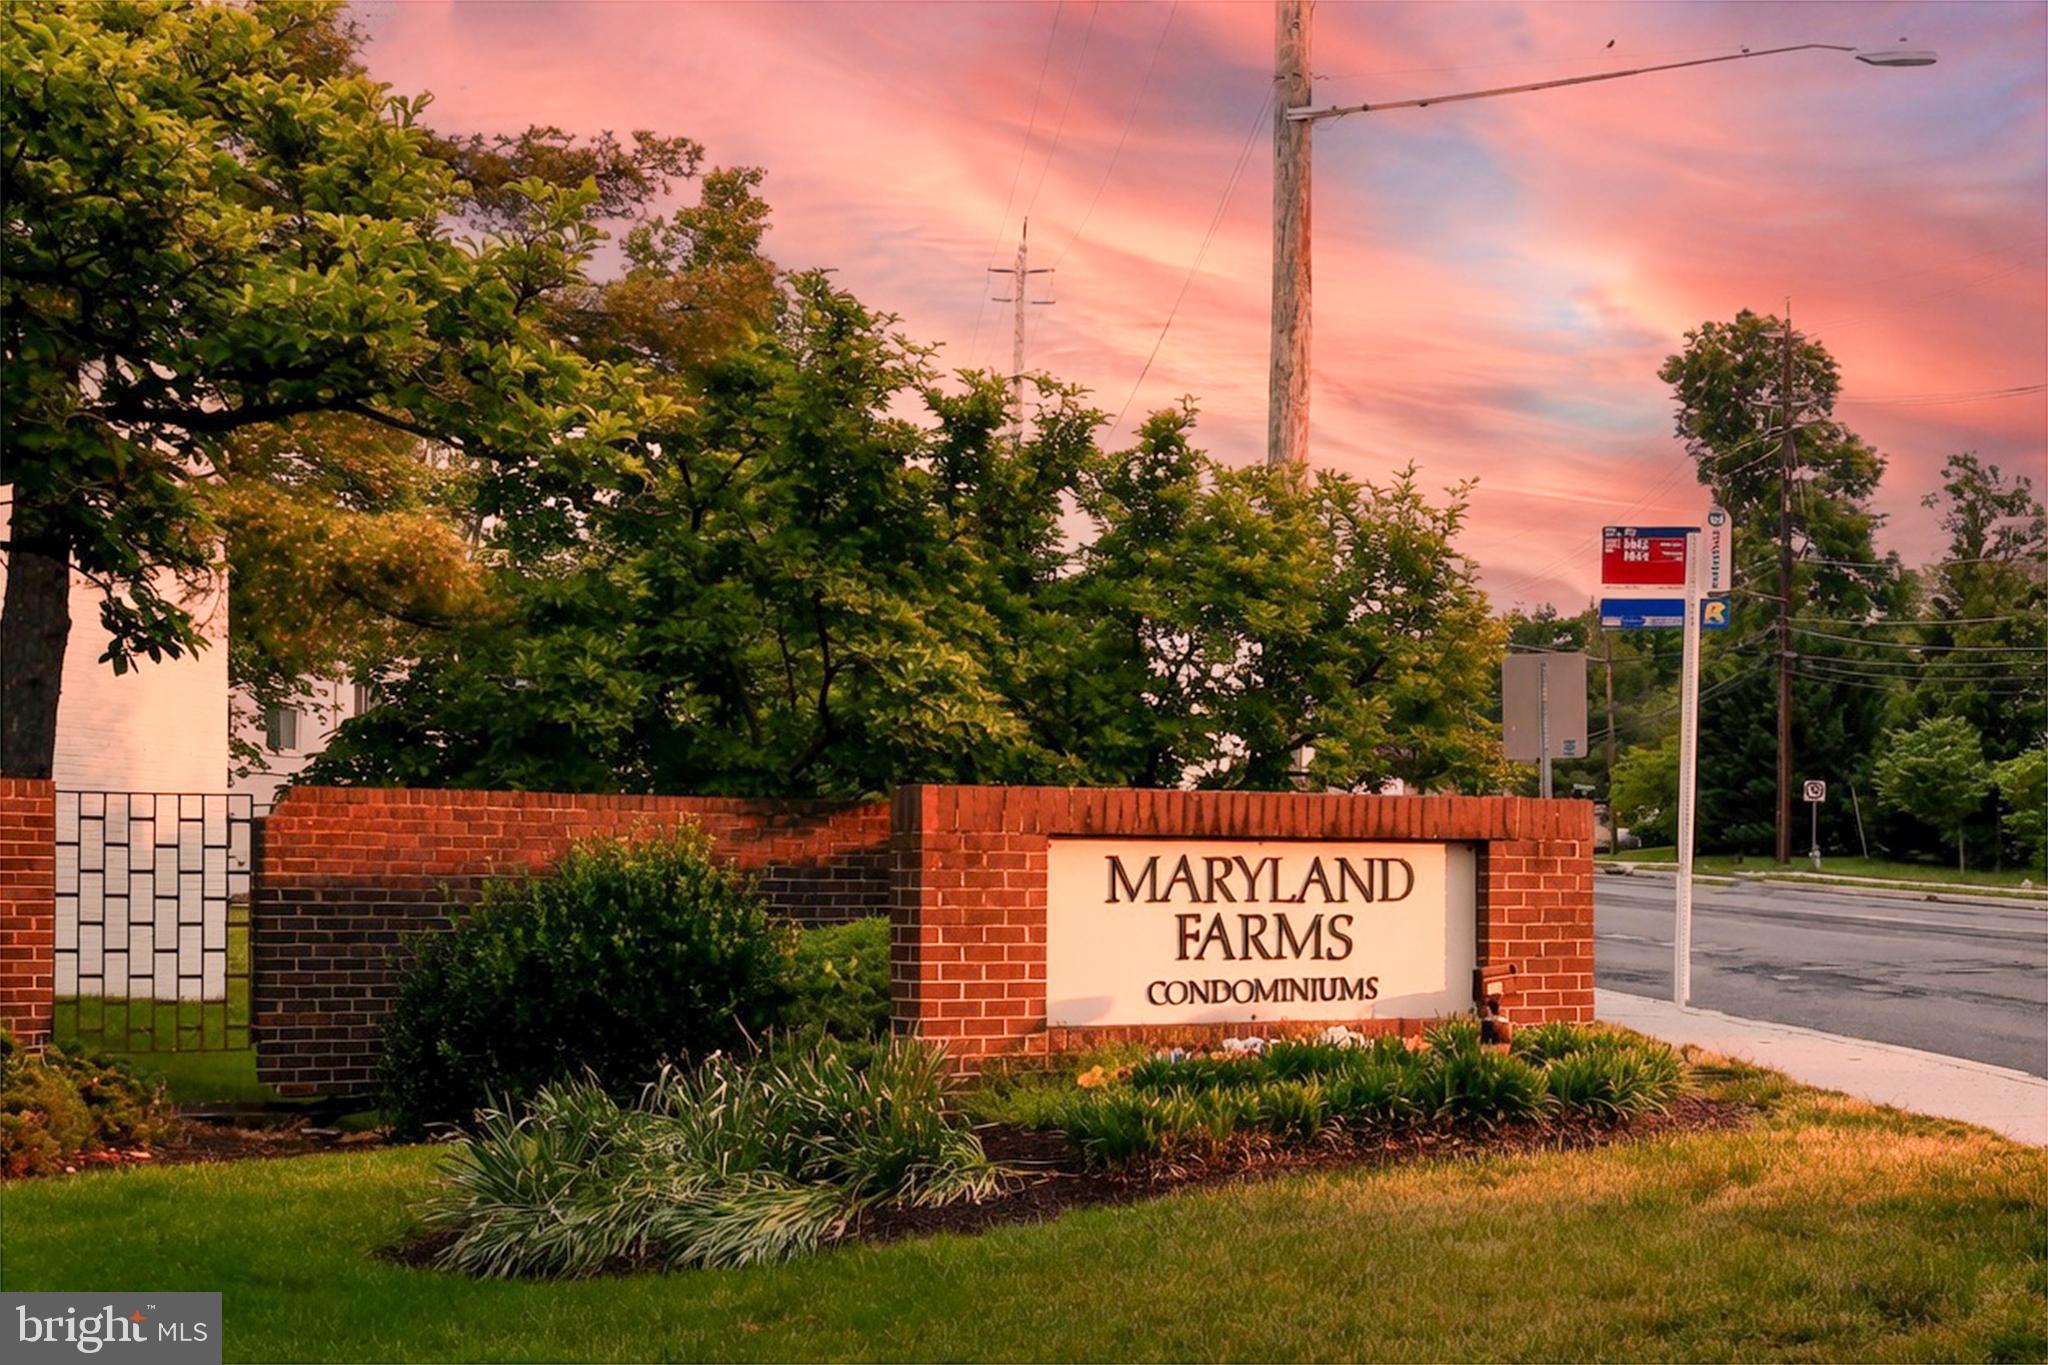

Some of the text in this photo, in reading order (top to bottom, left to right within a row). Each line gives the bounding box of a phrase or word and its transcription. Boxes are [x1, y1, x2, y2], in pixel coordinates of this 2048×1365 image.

[1104, 854, 1415, 904] MARYLAND
[1174, 912, 1354, 961] FARMS
[1146, 976, 1379, 1006] CONDOMINIUMS
